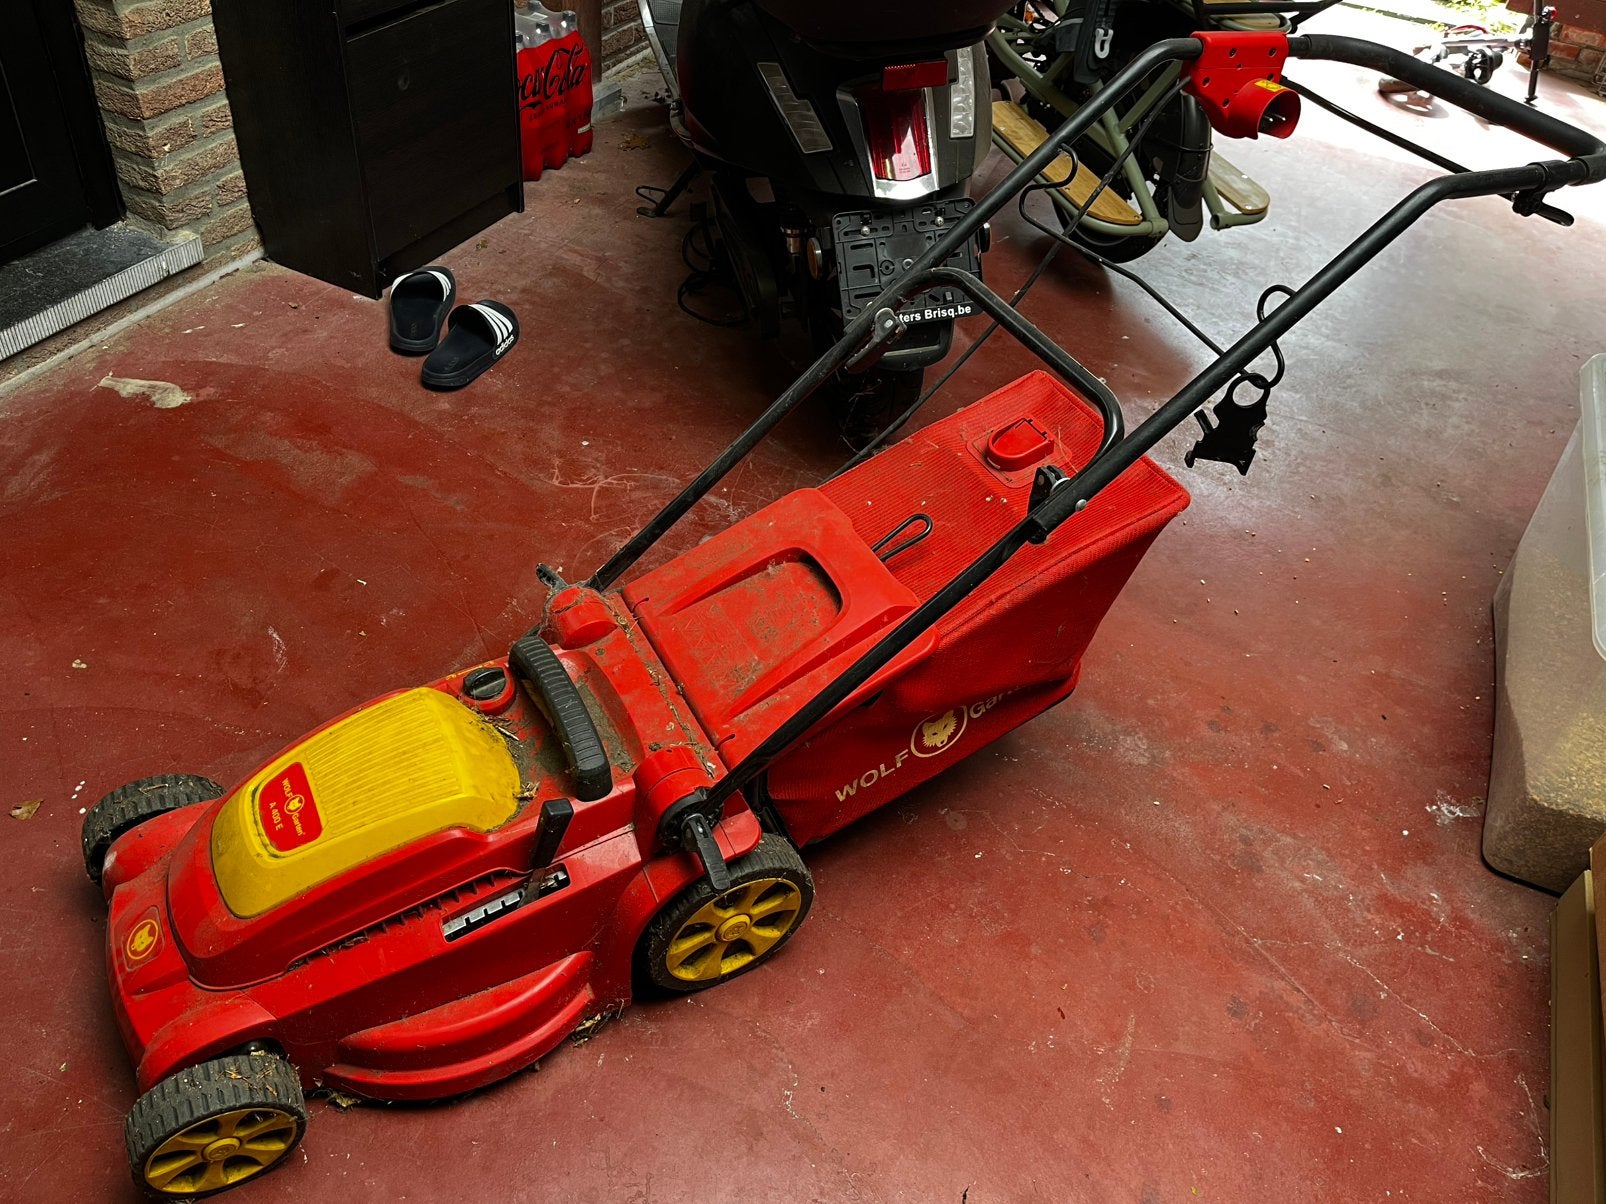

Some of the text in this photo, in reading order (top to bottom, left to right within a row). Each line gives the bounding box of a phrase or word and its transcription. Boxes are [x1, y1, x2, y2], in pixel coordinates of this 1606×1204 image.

[898, 305, 972, 323] ters Brisq.be
[496, 334, 514, 355] adidas
[834, 685, 1024, 802] WOLF Gar
[272, 808, 281, 824] 400
[282, 778, 304, 836] WOLF Garten
